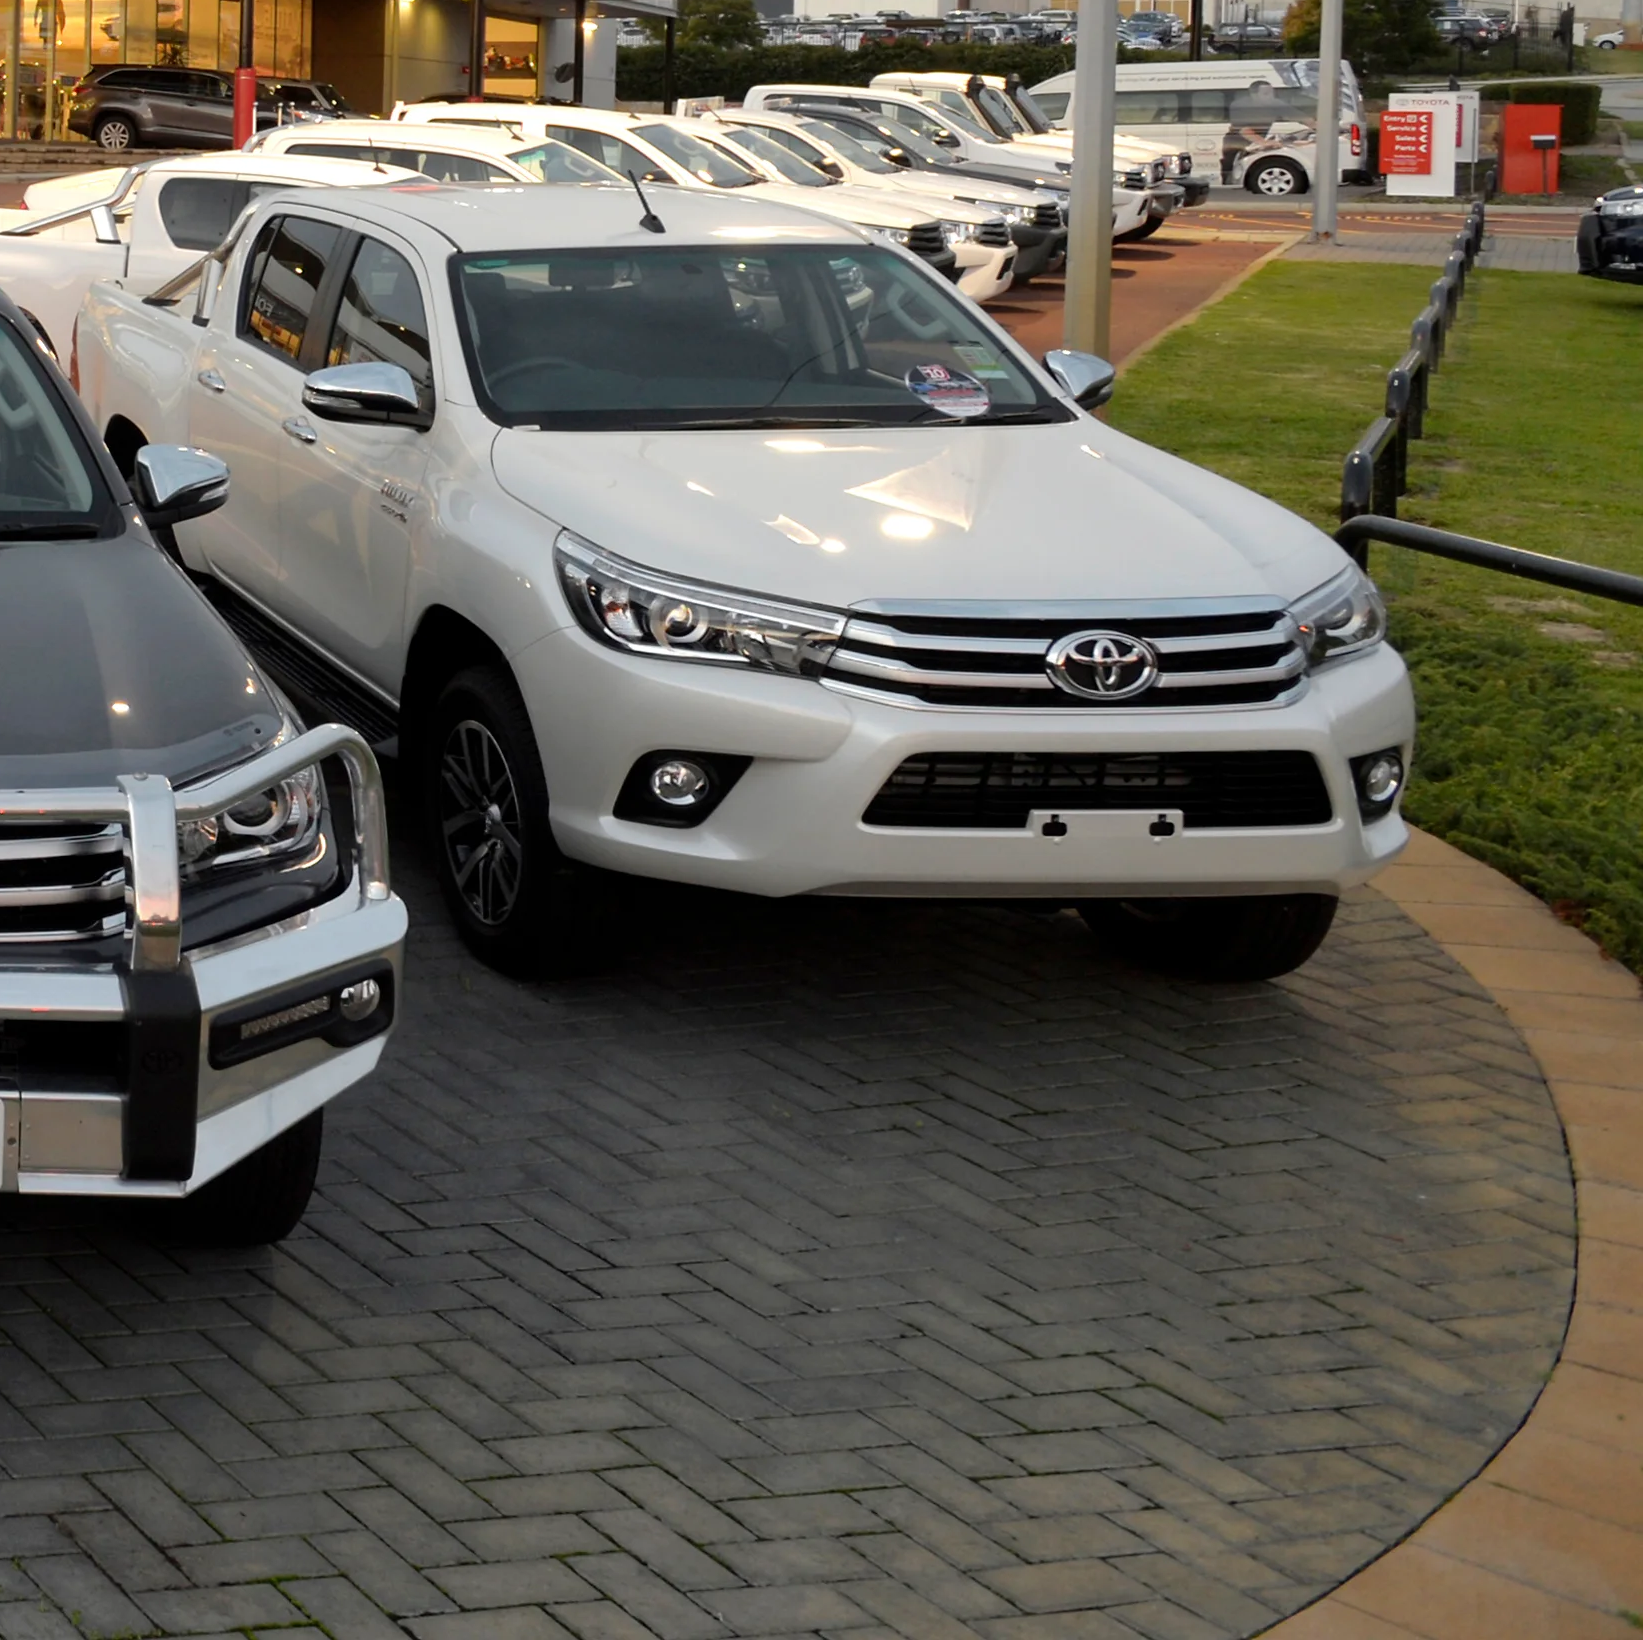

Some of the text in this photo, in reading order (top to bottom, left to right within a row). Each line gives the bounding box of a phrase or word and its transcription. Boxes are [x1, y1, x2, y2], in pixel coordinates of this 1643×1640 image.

[1383, 115, 1406, 124] Entry
[1395, 134, 1417, 142] Sales
[1395, 144, 1416, 152] Parts
